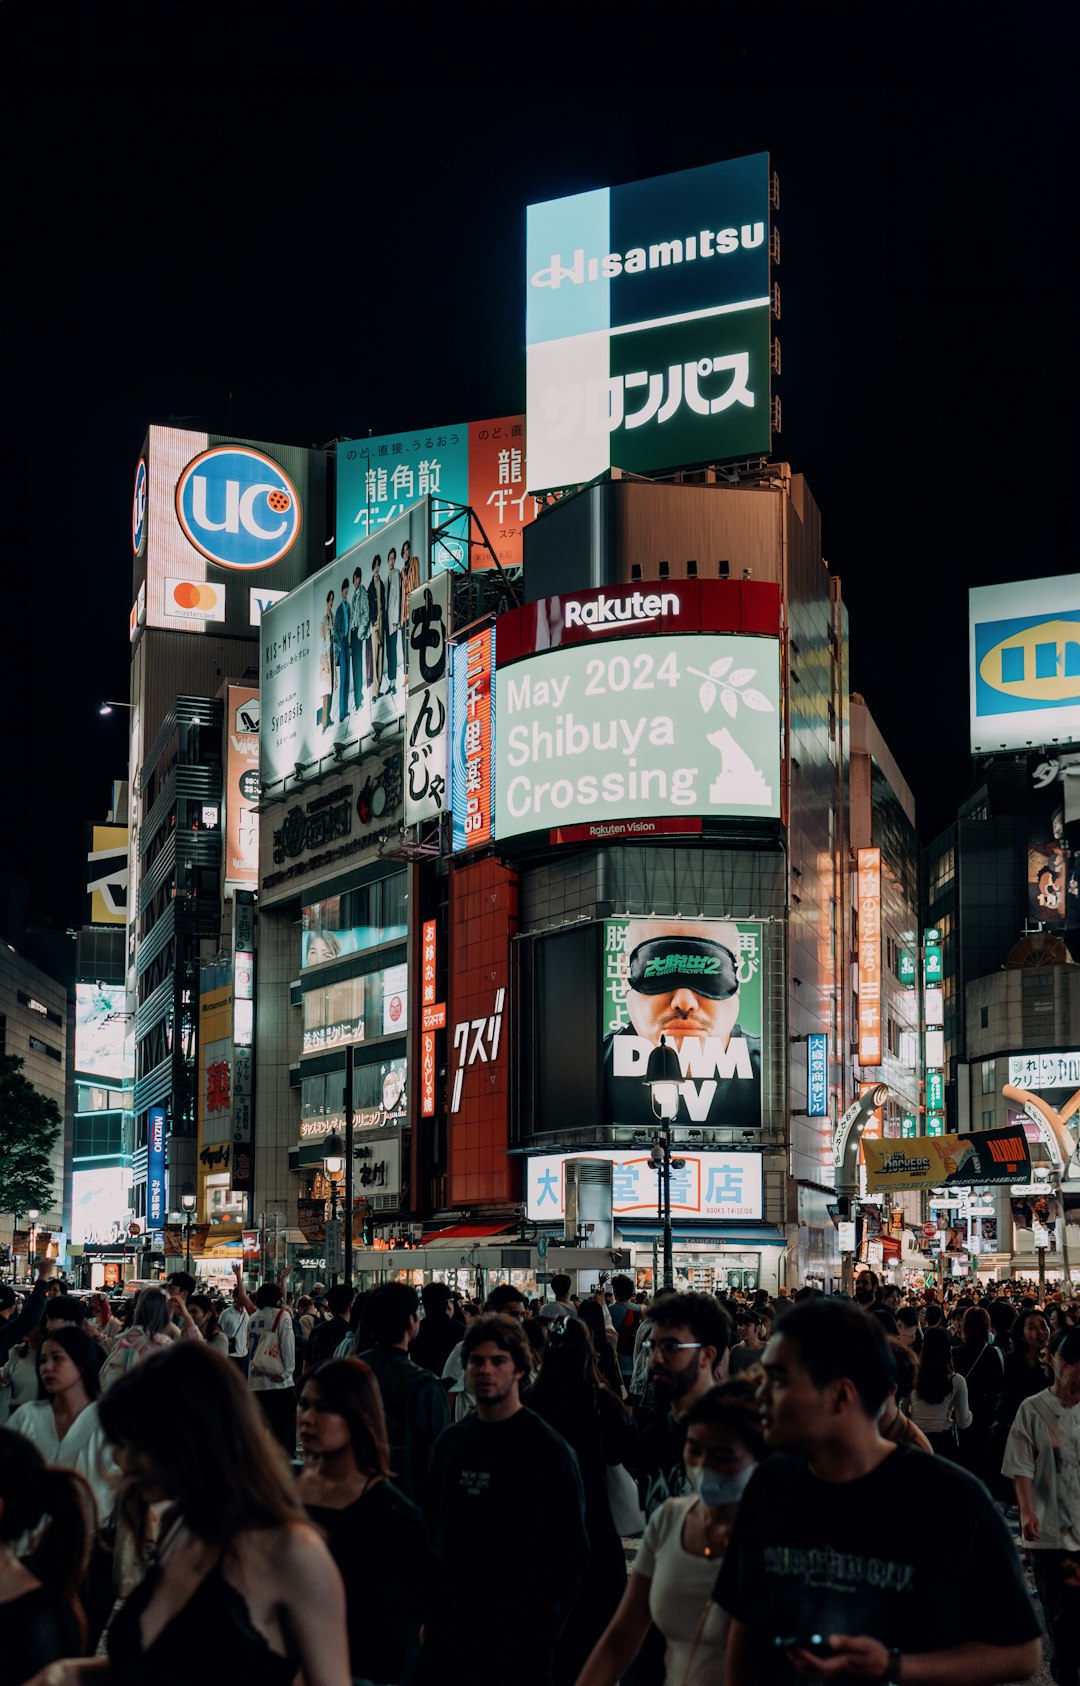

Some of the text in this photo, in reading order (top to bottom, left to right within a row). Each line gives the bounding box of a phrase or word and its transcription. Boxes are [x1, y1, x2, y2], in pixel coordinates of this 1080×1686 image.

[531, 222, 764, 289] Hisamitsu
[347, 434, 460, 461] のど、直接、うるおう
[498, 448, 526, 485] 龍
[365, 459, 442, 503] 龍角散
[564, 592, 681, 631] Rakuten
[265, 619, 311, 664] KIS-MY-FT2
[407, 588, 446, 809] もんじゃ
[507, 651, 680, 714] May 2024
[271, 702, 303, 733] Synopsis
[464, 639, 485, 834] 三千里薬品
[507, 714, 675, 768] Shibuya
[507, 760, 698, 818] Crossing
[589, 821, 656, 837] Rakuten Vision
[605, 926, 631, 1030] 脱出せよ
[735, 932, 760, 984] 再び
[207, 1060, 231, 1112] 薬
[811, 1038, 824, 1113] 大盛堂商事ビル
[154, 1115, 164, 1153] MIZUHO
[301, 1112, 380, 1137] ジャスミンレディークリニック
[151, 1180, 161, 1220] みずほ銀行
[536, 1164, 744, 1207] 大堂書店
